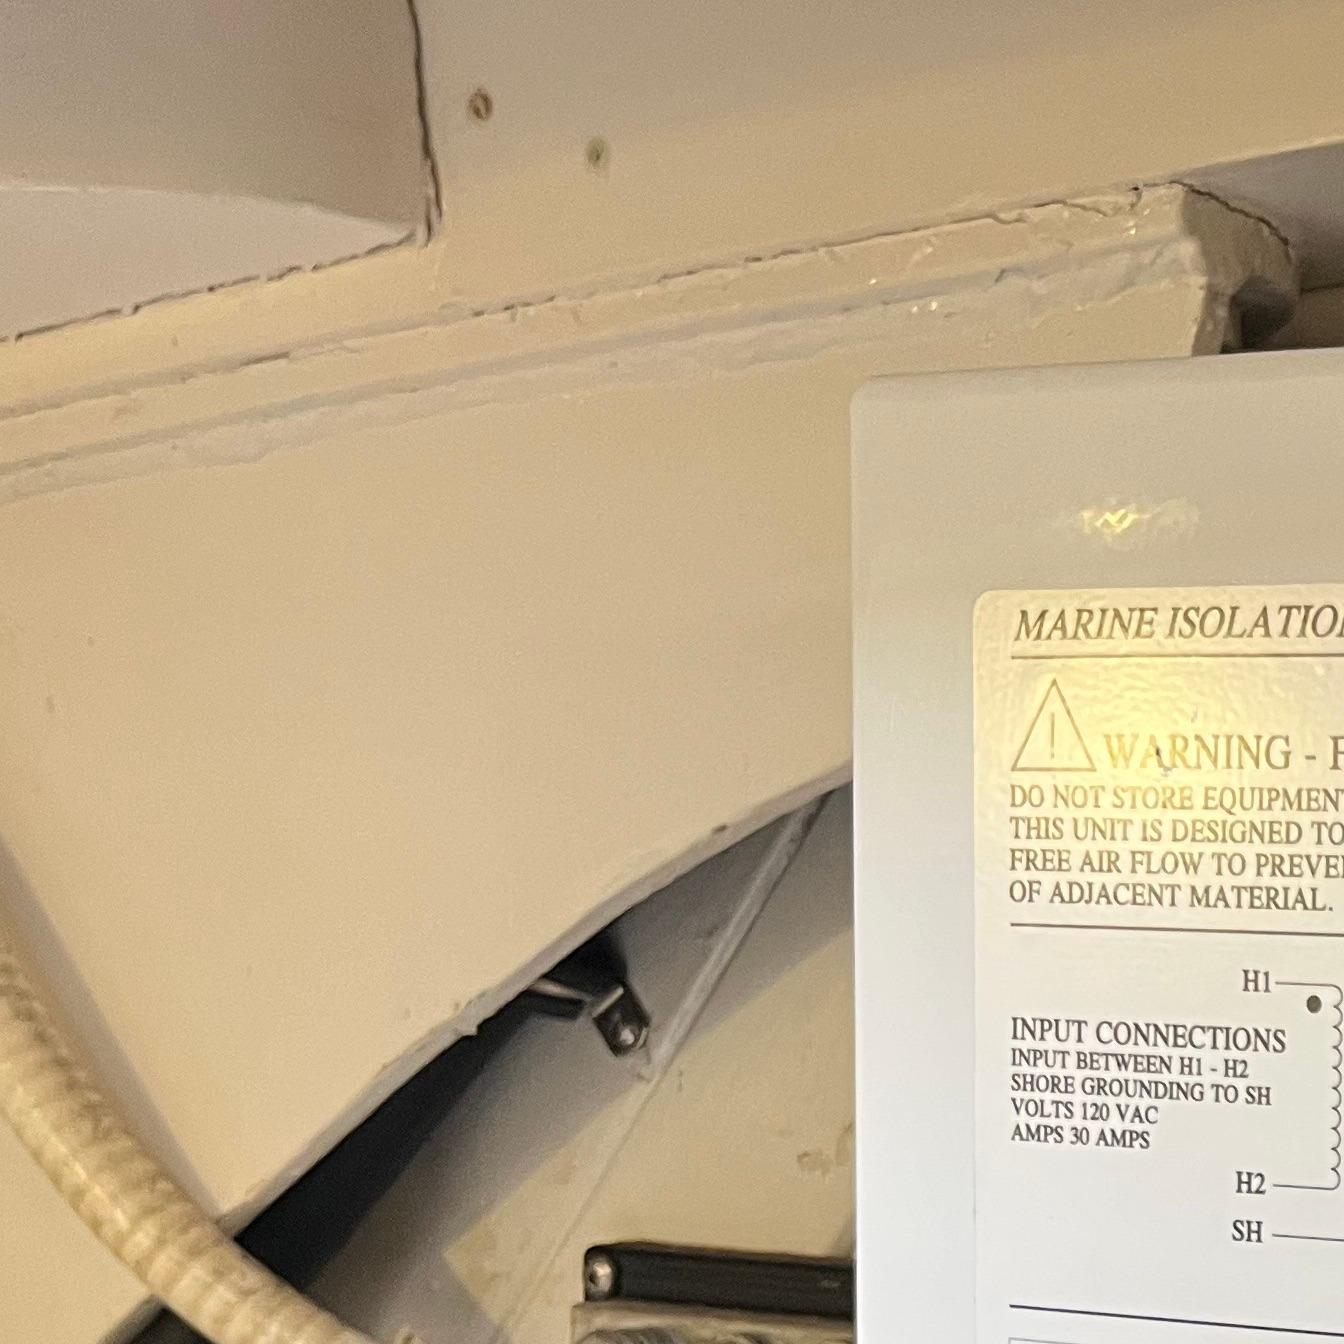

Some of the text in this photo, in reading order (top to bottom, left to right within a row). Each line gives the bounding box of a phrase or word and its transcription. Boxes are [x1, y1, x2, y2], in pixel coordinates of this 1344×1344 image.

[1013, 606, 1159, 642] MARINE
[1104, 735, 1293, 773] WARNING
[1009, 783, 1045, 808] DO
[1053, 783, 1106, 809] NOT
[1112, 786, 1194, 811] STORE
[1008, 815, 1065, 841] THIS
[1072, 816, 1134, 842] UNIT
[1140, 818, 1163, 843] IS
[1171, 818, 1304, 845] DESIGNED
[1008, 847, 1072, 873] FREE
[1078, 849, 1123, 874] AIR
[1129, 849, 1205, 876] FLOW
[1210, 851, 1247, 877] TO
[1008, 879, 1334, 912] OF ADJACENT MATERIAL.
[1241, 968, 1272, 994] H1
[1010, 1016, 1287, 1054] INPUT CONNECTIONS
[1010, 1047, 1071, 1070] INPUT
[1075, 1050, 1174, 1075] BETWEEN
[1178, 1055, 1204, 1077] H1
[1223, 1057, 1250, 1079] H2
[1010, 1072, 1273, 1107] SHORE GROUNDING TO SH
[1010, 1096, 1159, 1125] VOLTS 120 VAC
[1010, 1122, 1151, 1150] AMPS 30 AMPS
[1235, 1170, 1267, 1196] H2
[1231, 1218, 1264, 1244] SH
